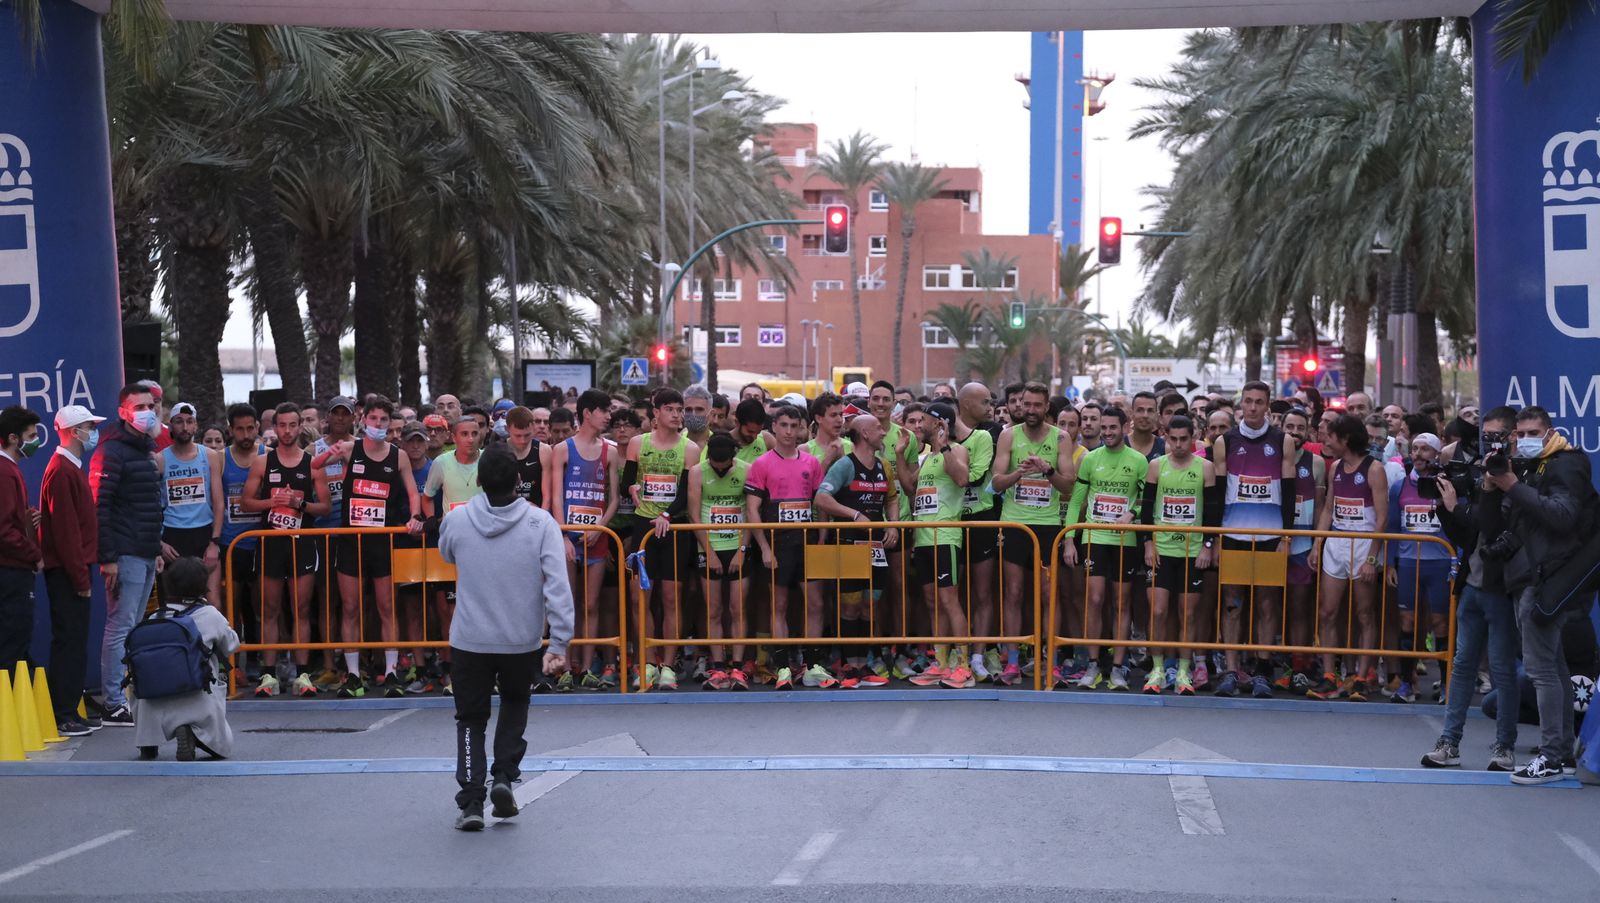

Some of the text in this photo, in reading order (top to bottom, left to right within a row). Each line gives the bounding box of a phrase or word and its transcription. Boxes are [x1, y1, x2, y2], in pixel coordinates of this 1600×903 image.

[168, 466, 199, 478] nerja
[175, 485, 198, 497] 587
[647, 483, 672, 492] 3543
[1021, 488, 1046, 497] 3363
[1244, 484, 1267, 494] 108
[357, 507, 379, 518] 541
[1099, 504, 1123, 513] 3129
[1169, 505, 1190, 515] 192
[575, 515, 597, 525] 482
[717, 515, 738, 524] 350
[786, 510, 808, 520] 314
[275, 515, 297, 527] 463
